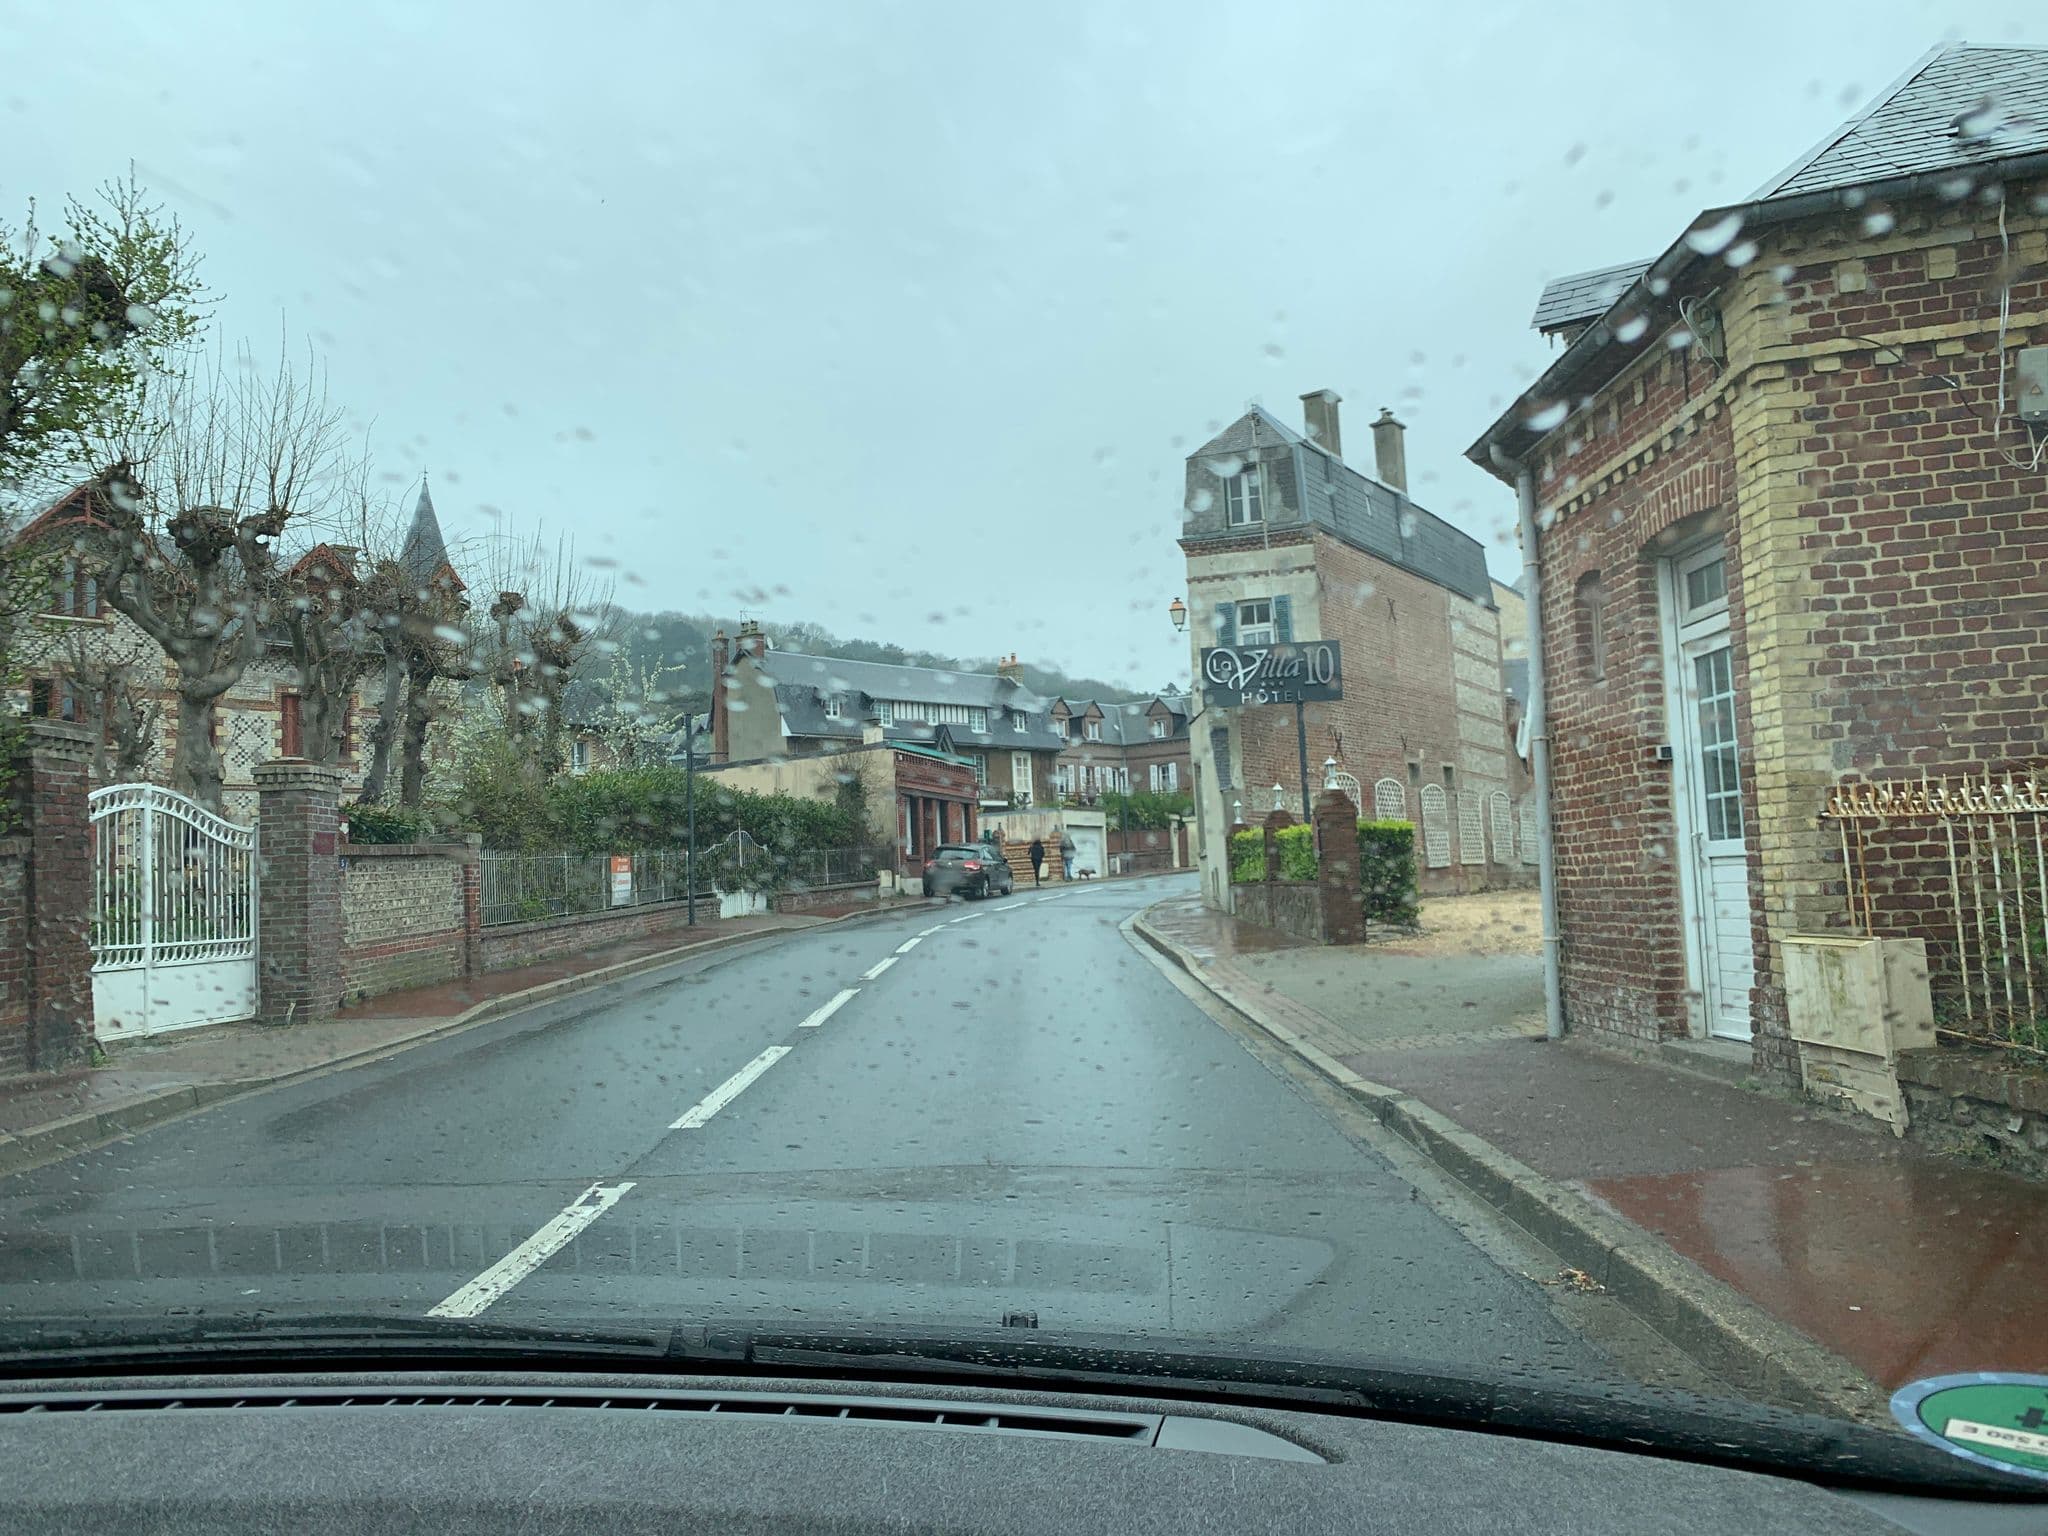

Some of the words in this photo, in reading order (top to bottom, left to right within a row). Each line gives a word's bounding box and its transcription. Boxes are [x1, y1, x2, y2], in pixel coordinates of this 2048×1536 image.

[1207, 648, 1304, 690] Villa
[1213, 659, 1232, 672] La
[1303, 645, 1334, 685] 10
[1241, 689, 1304, 704] HÔTEL
